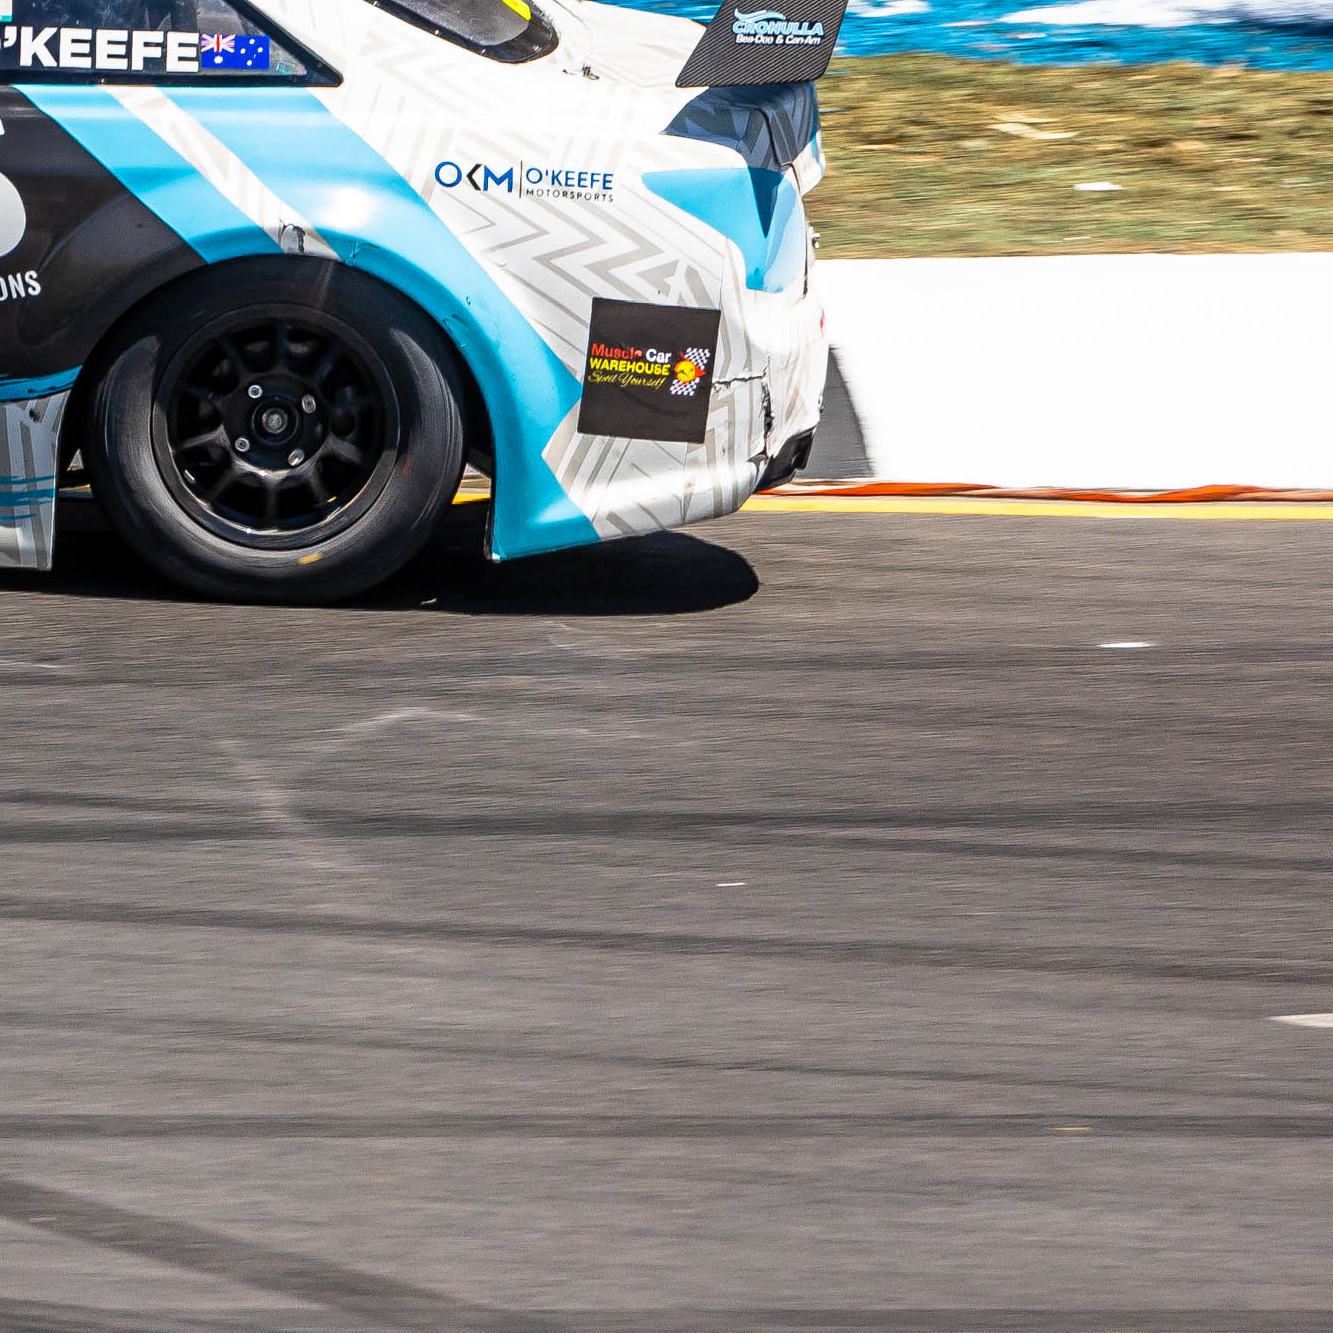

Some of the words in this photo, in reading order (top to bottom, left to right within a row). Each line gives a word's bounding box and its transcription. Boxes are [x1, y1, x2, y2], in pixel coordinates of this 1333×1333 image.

[732, 20, 825, 36] CRONULLA
[775, 34, 784, 44] &
[526, 167, 614, 191] O'KEEFE
[526, 188, 614, 203] MOTORSPORTS
[645, 348, 672, 364] Car
[589, 357, 671, 376] WAREHOUSE
